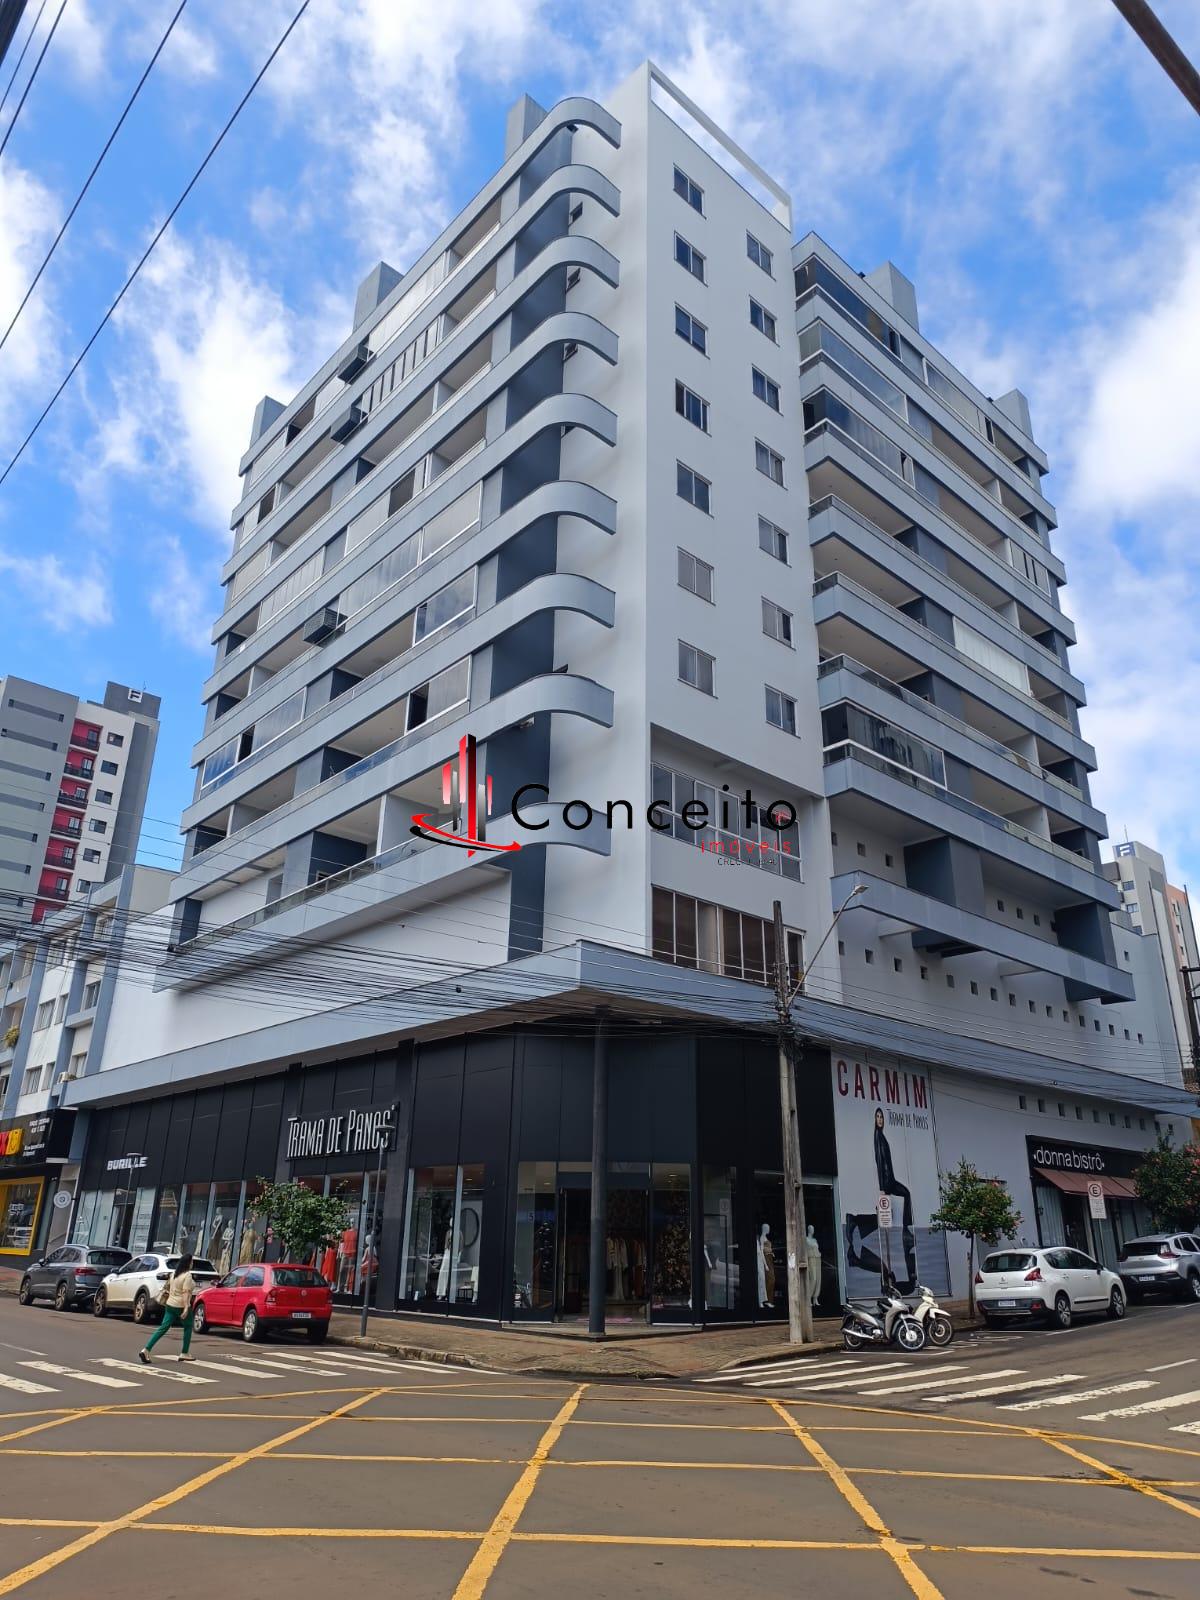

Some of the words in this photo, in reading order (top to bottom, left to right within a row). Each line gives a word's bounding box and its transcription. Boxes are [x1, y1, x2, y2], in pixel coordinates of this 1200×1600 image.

[837, 1060, 927, 1109] CARMIM
[287, 1117, 324, 1157] TRAMA
[326, 1117, 343, 1153] DE
[346, 1109, 390, 1152] PANOS
